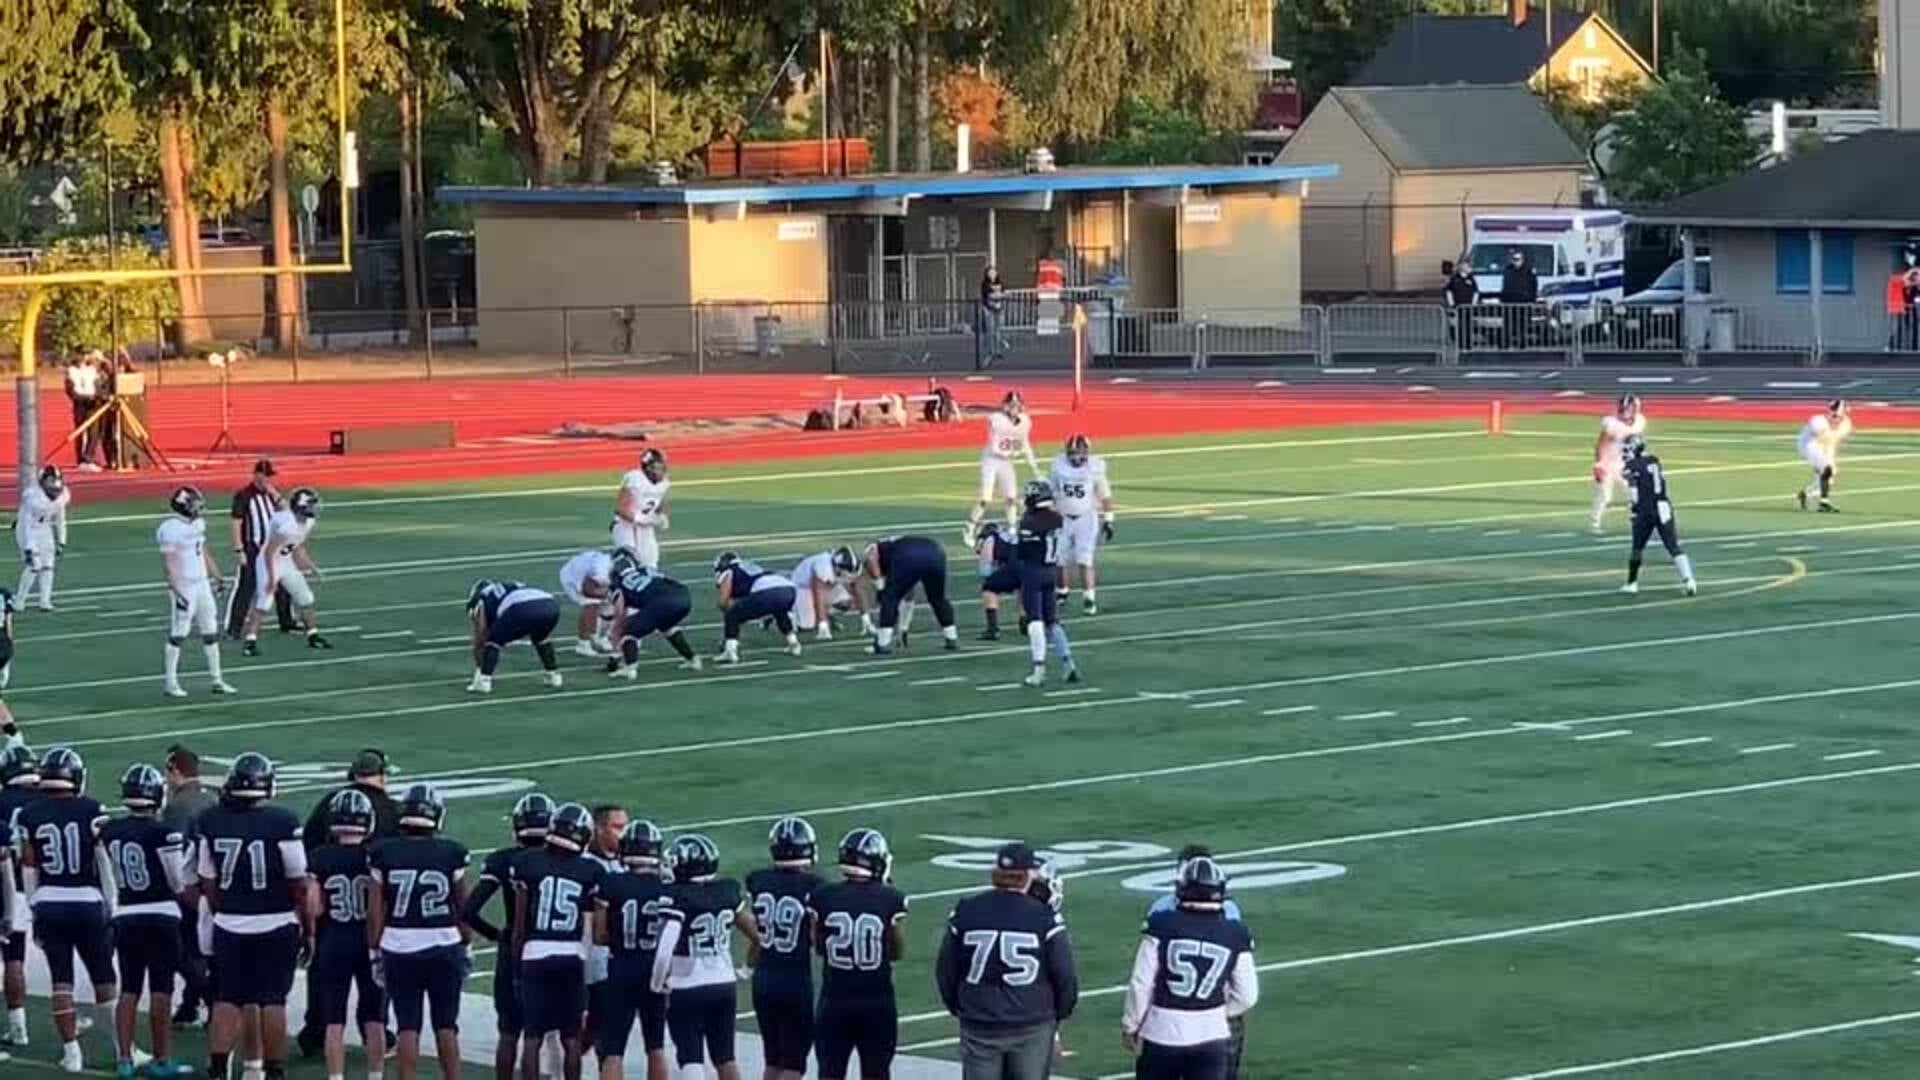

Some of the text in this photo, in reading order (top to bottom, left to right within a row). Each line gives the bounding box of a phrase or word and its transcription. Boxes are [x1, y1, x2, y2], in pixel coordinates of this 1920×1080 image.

[36, 822, 80, 875] 31
[108, 839, 151, 891] 18
[213, 837, 267, 890] 71
[323, 873, 373, 922] 30
[388, 869, 450, 918] 72
[536, 876, 583, 931] 15
[752, 892, 804, 952] 39
[824, 911, 884, 971] 20
[964, 929, 1040, 986] 75
[1167, 939, 1232, 999] 57
